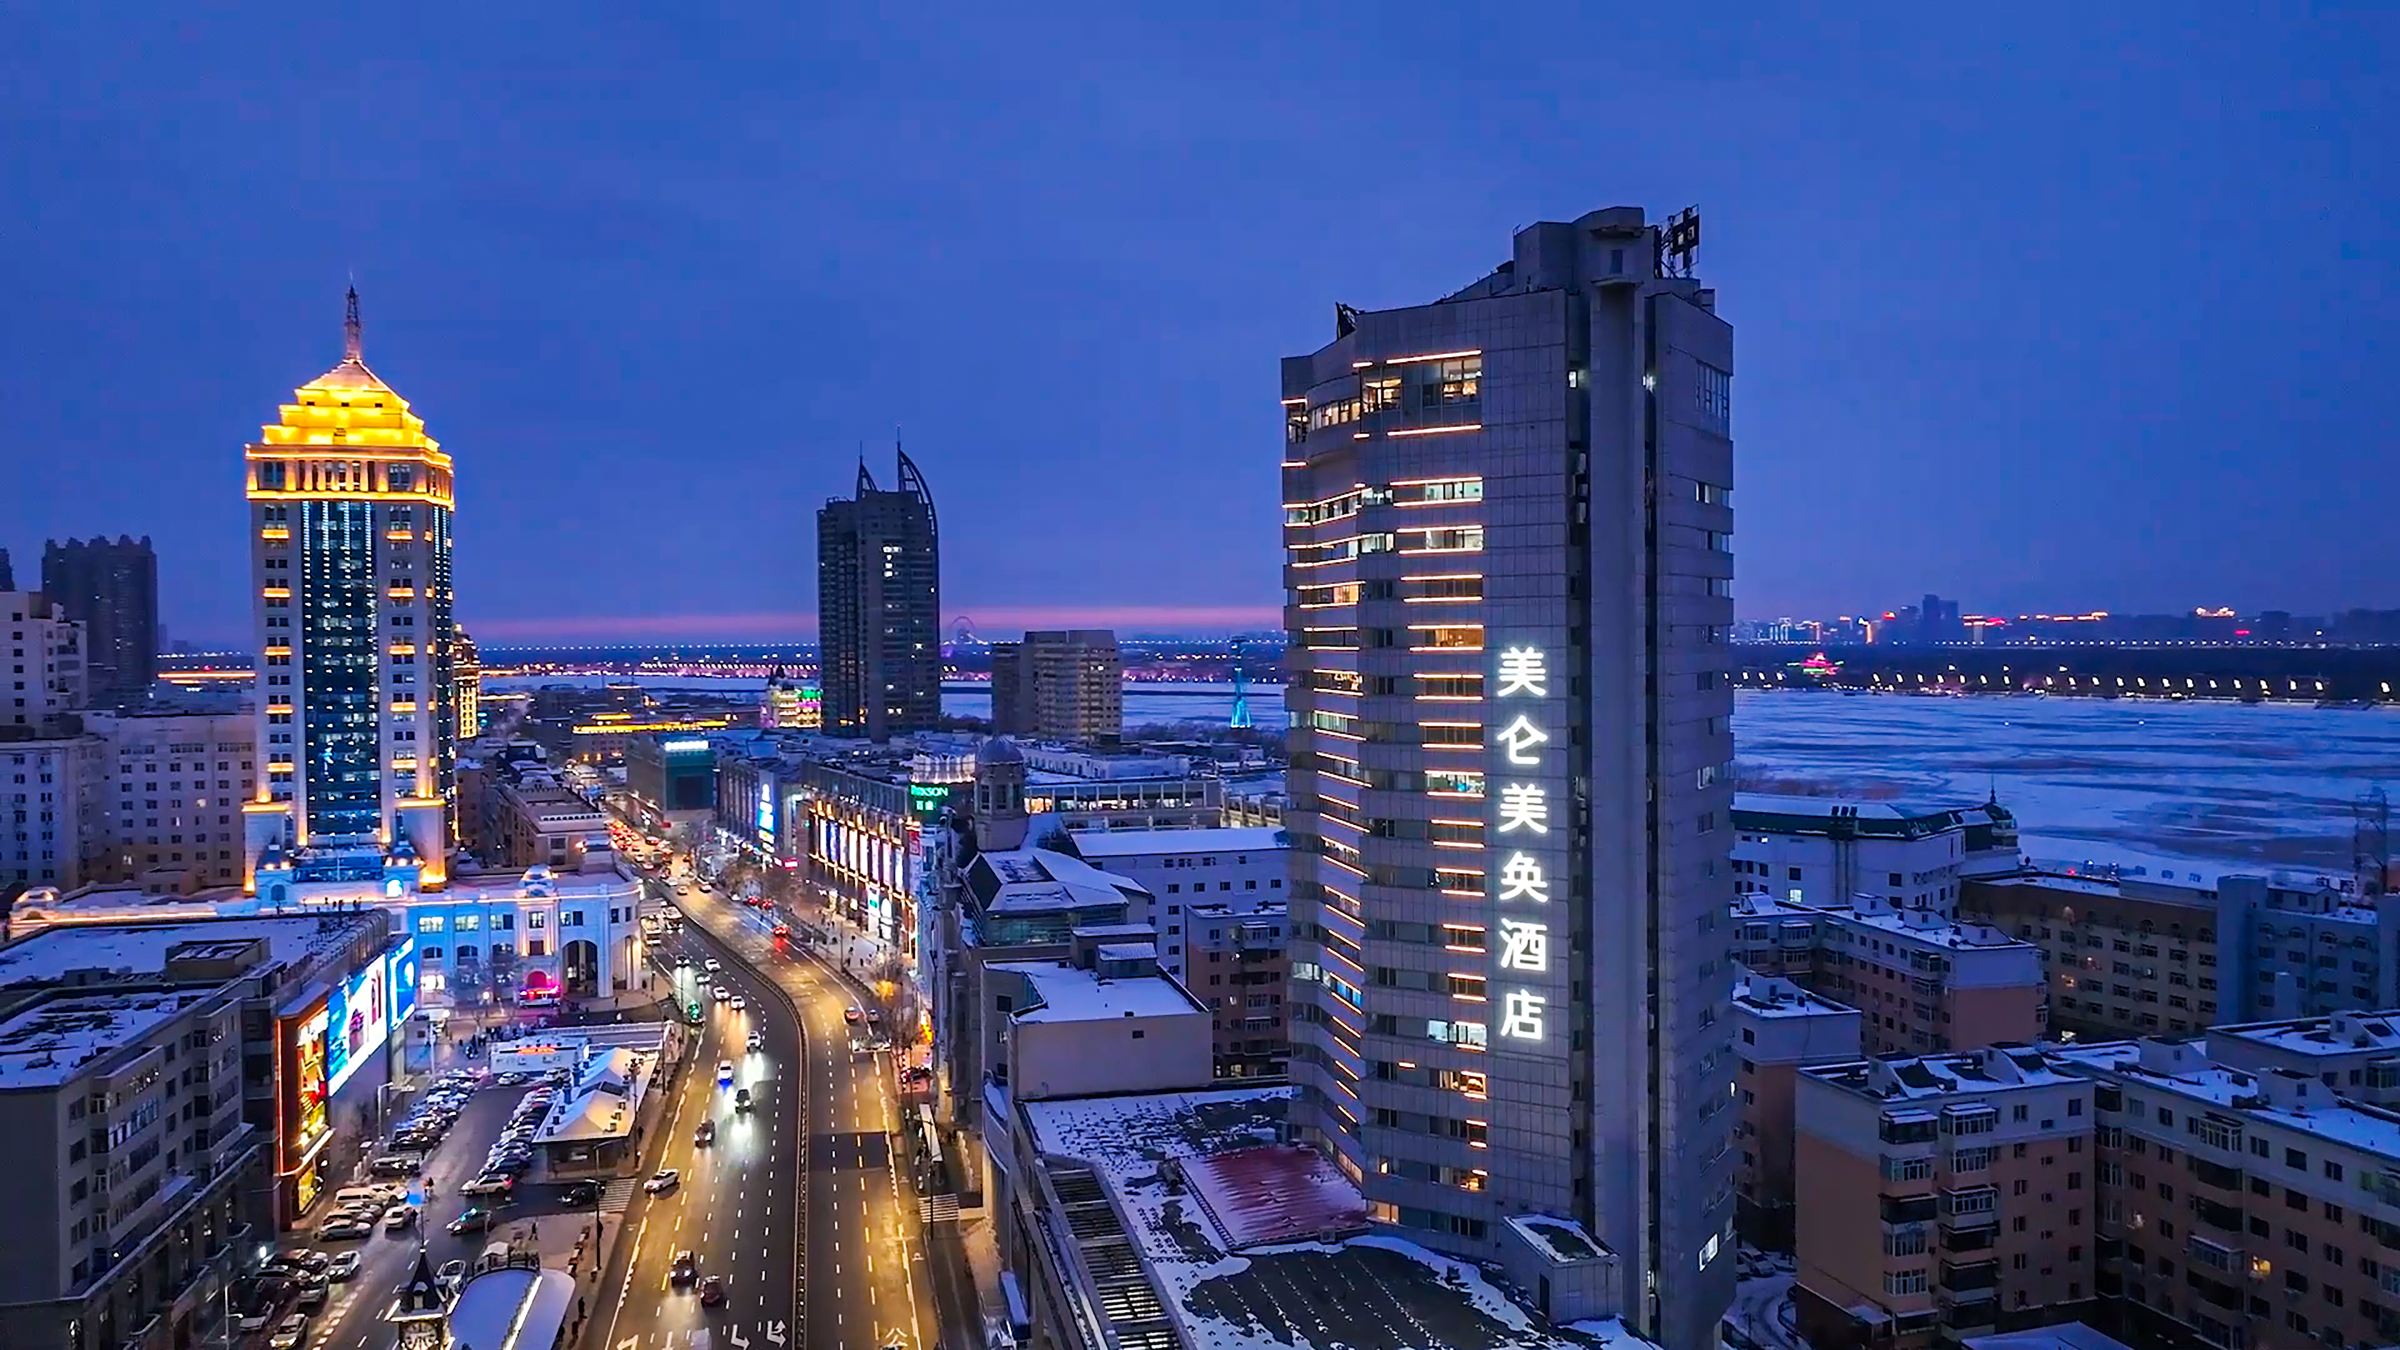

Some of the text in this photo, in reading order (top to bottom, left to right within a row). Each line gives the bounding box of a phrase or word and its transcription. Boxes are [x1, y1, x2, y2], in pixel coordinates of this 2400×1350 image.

[1497, 647, 1548, 1040] 美仑美奂酒店
